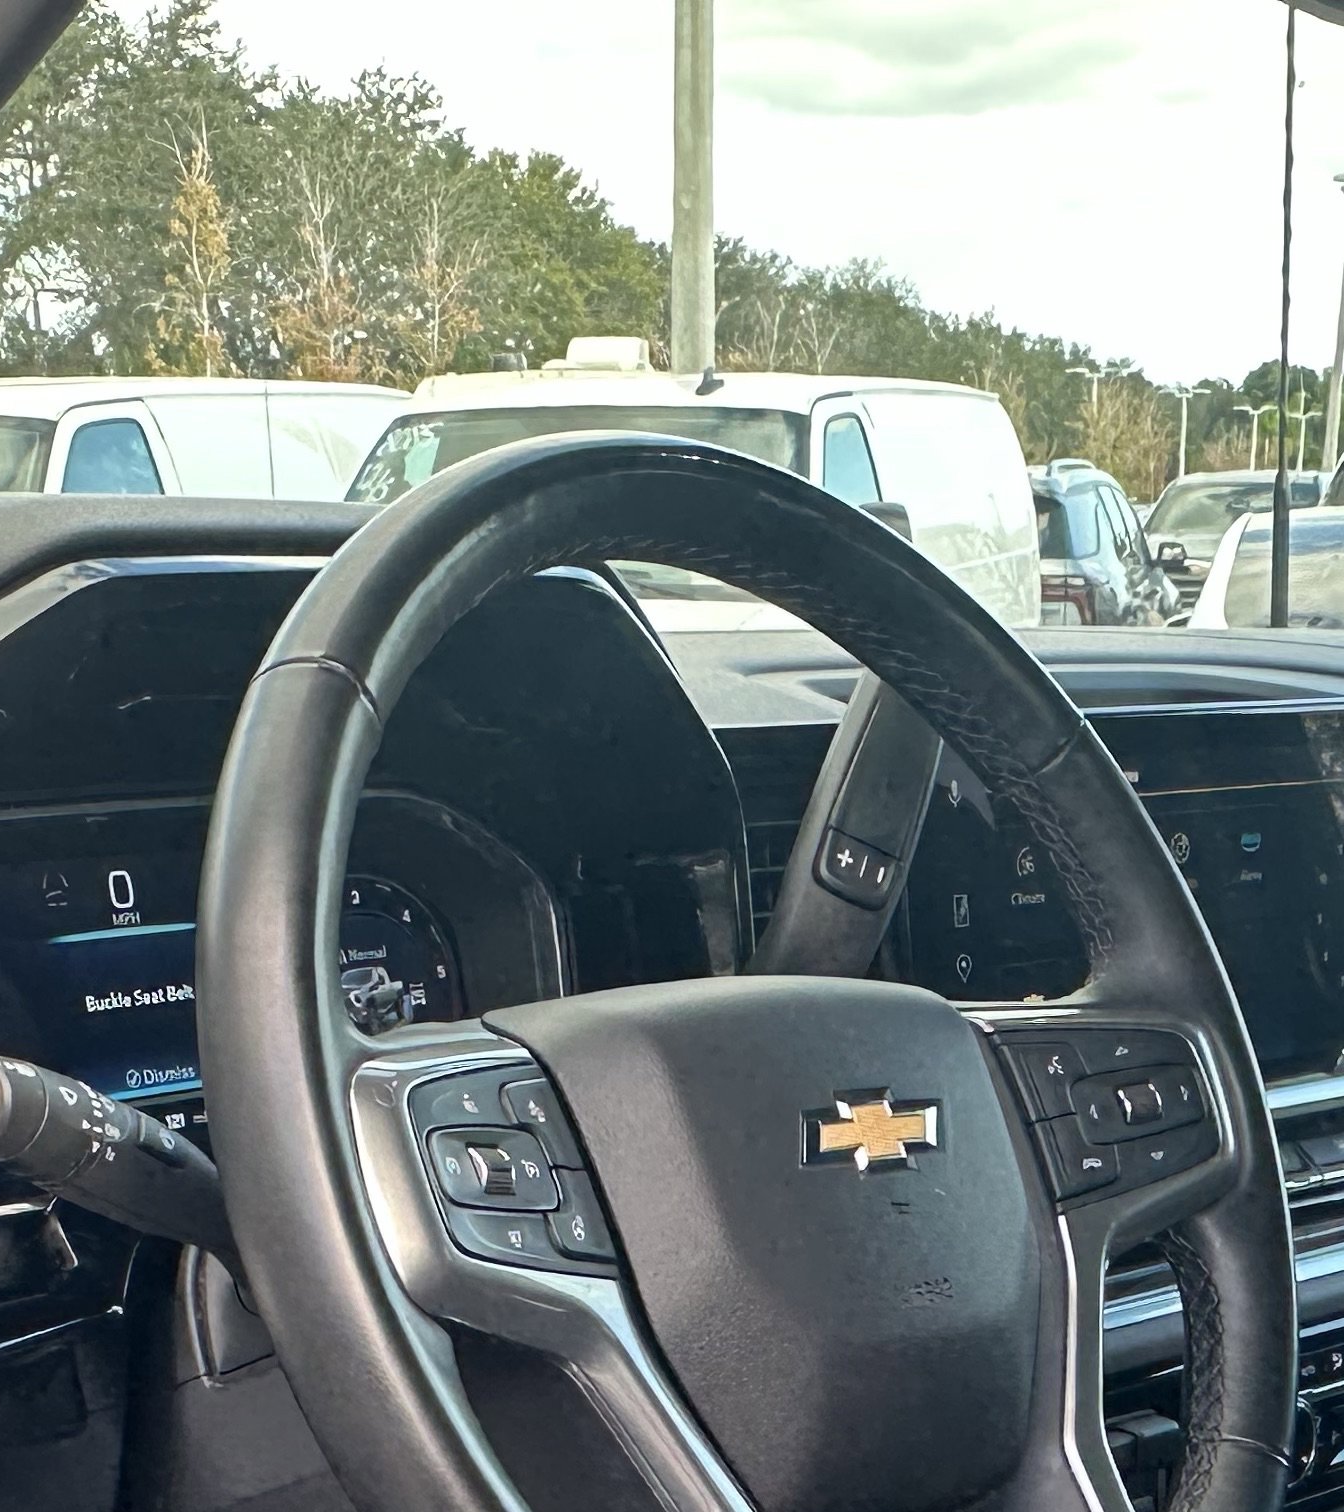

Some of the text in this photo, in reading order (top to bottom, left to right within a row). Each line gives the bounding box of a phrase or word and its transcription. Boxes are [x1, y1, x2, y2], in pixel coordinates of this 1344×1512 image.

[108, 869, 135, 909] 0
[85, 991, 133, 1013] Buckle
[133, 988, 166, 1006] Seat
